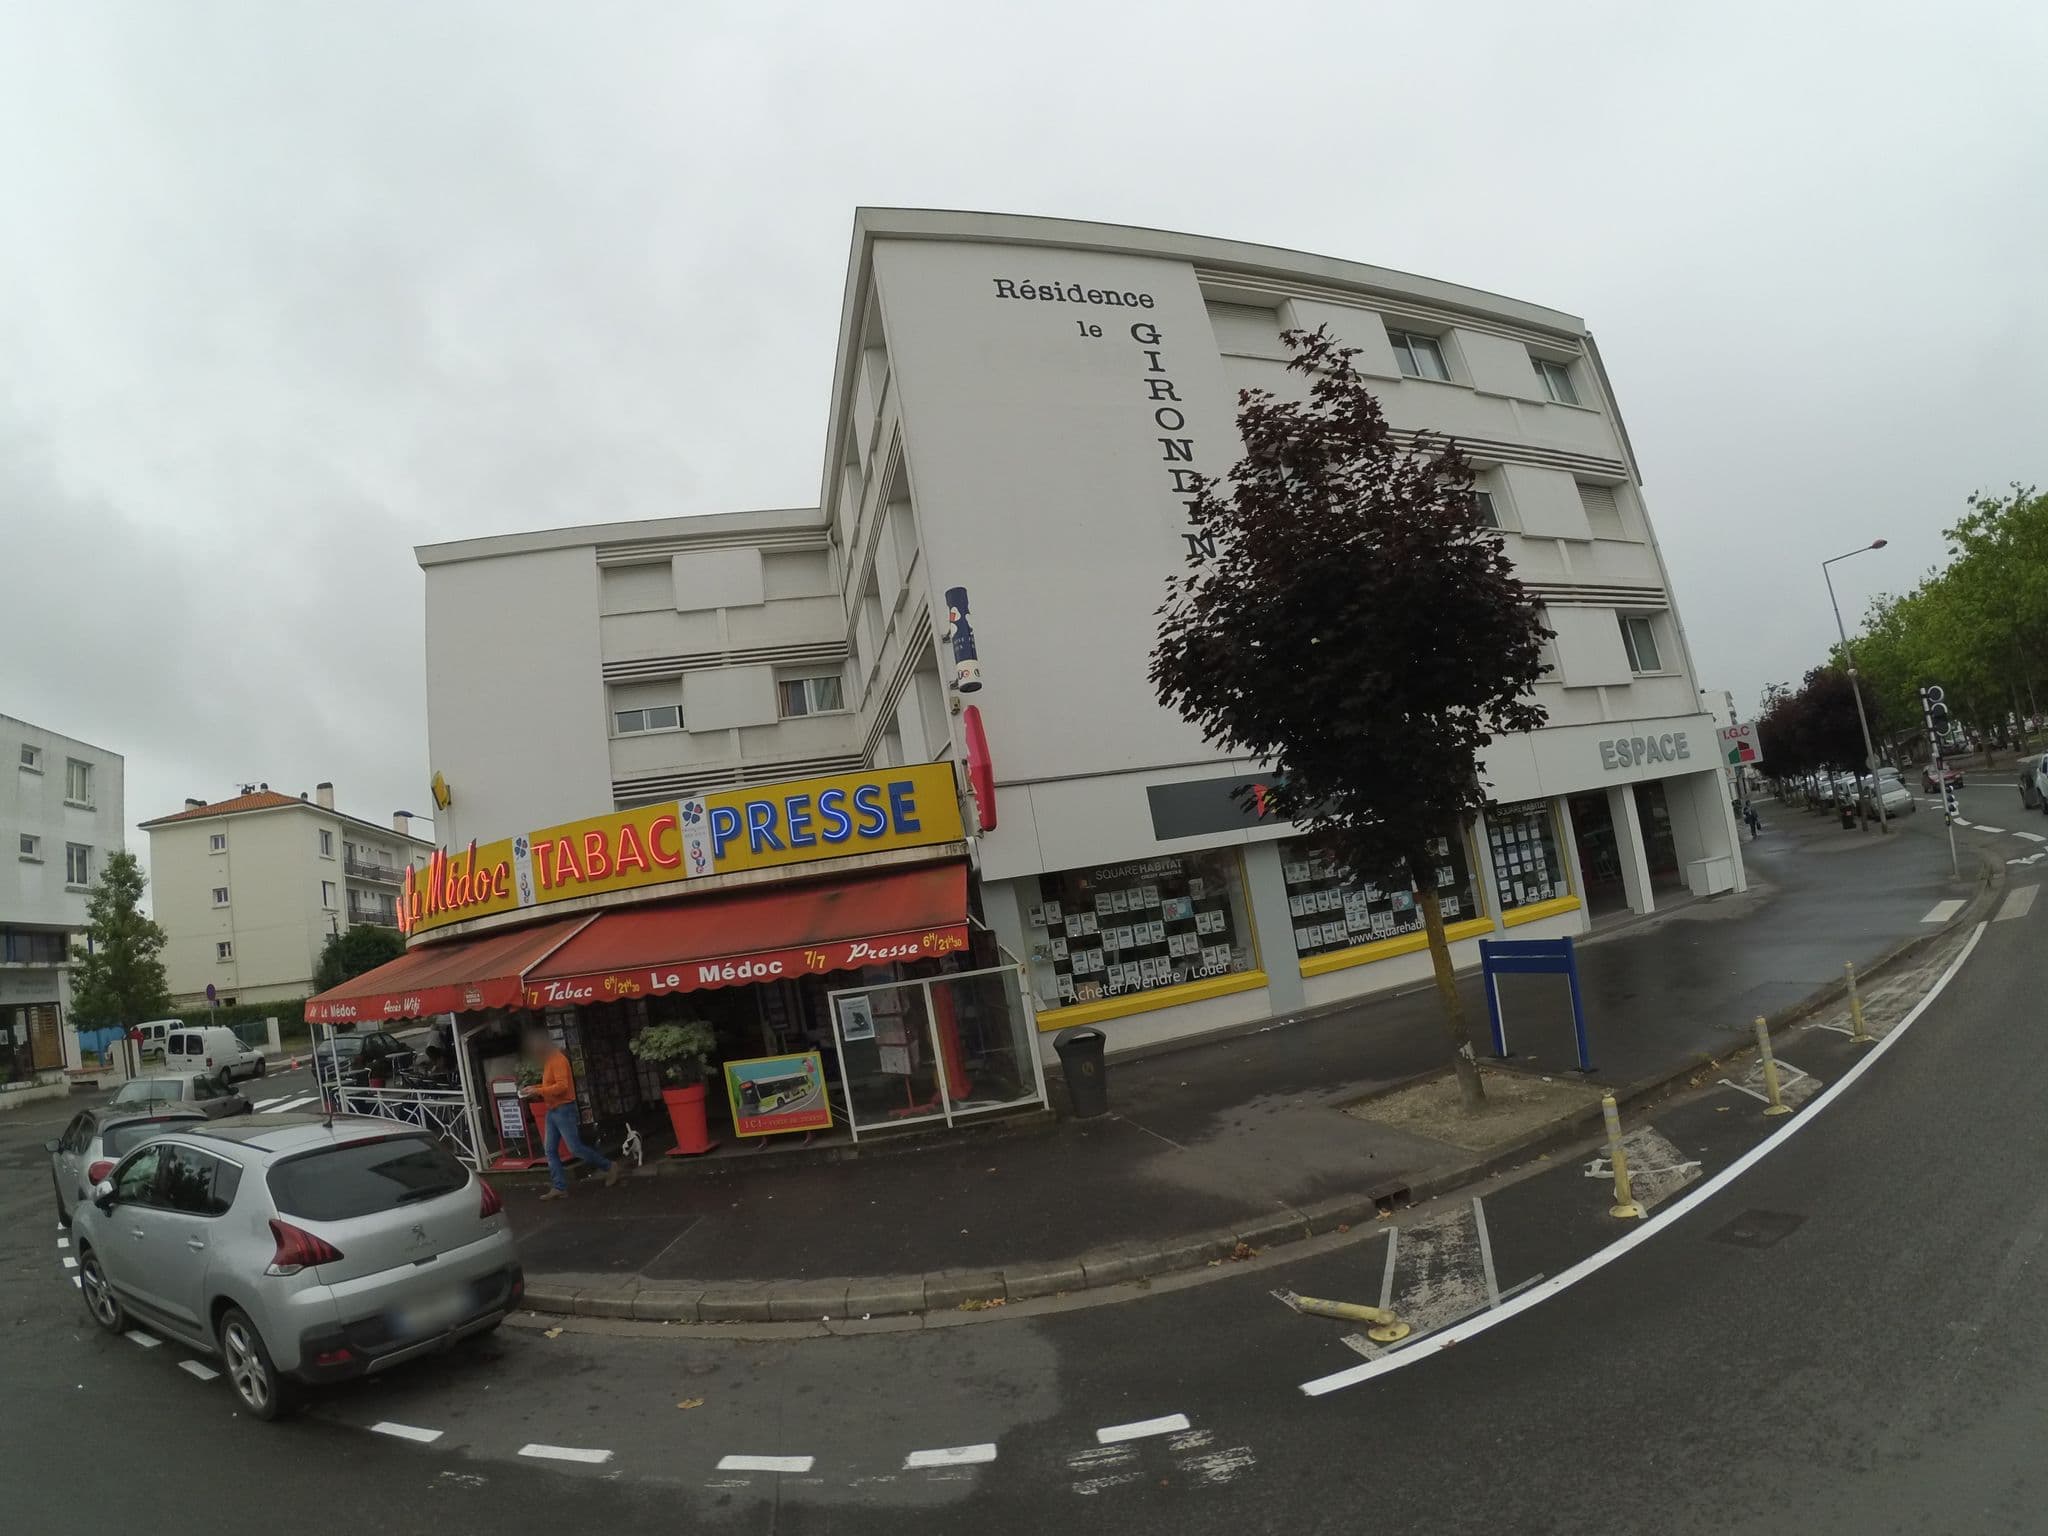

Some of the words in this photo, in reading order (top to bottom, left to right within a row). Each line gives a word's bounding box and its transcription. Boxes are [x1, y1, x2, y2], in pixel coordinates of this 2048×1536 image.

[993, 278, 1155, 308] Résidence
[1076, 320, 1103, 339] le
[1599, 732, 1691, 770] ESPACE
[709, 780, 921, 859] PRESSE
[530, 814, 681, 888] TABAC
[1095, 864, 1139, 880] SQUARE
[1139, 858, 1183, 874] HABITAT
[425, 838, 509, 917] Médoc
[544, 982, 593, 1002] Tabac
[651, 971, 680, 990] Le
[699, 960, 783, 982] Médoc
[804, 951, 826, 969] 7/7
[847, 942, 919, 962] Presse
[1068, 983, 1126, 1003] Acheter
[1132, 970, 1181, 990] Vendre
[1192, 962, 1229, 979] Louer
